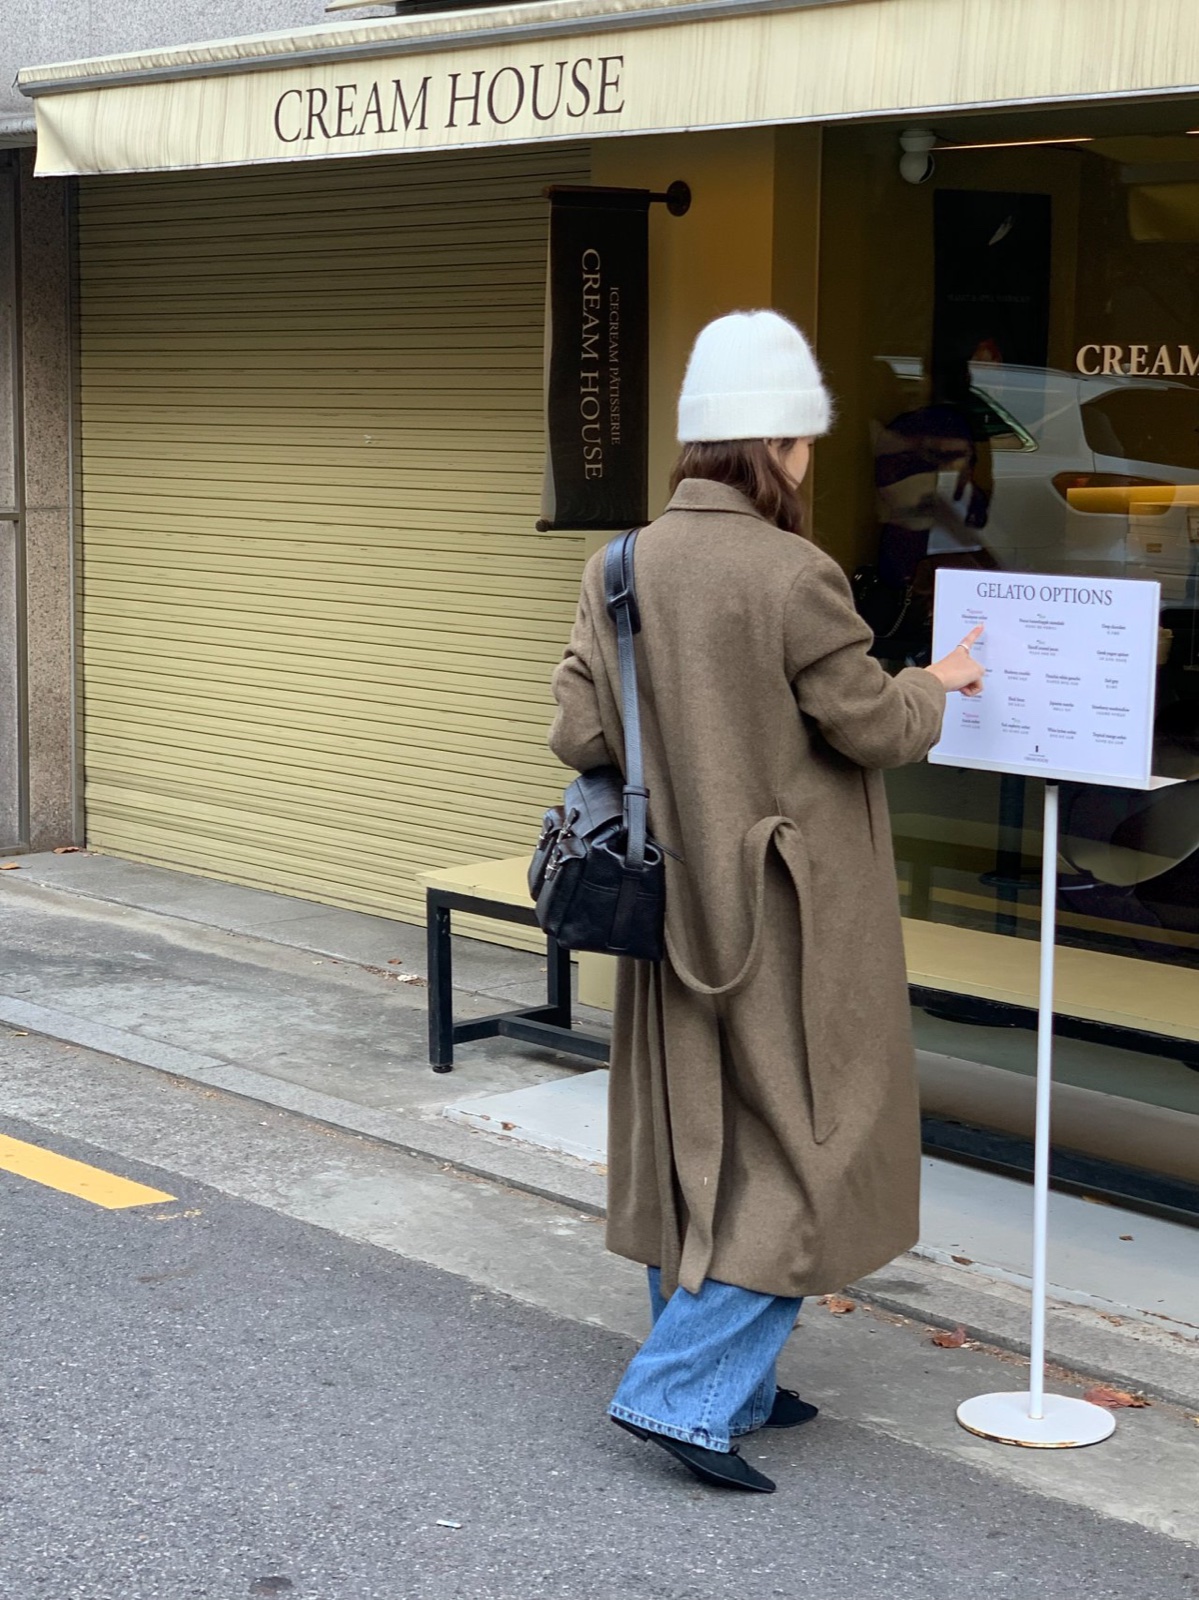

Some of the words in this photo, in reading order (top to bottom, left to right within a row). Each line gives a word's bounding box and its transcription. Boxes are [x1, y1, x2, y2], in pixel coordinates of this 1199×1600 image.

[274, 77, 432, 143] CREAM
[445, 55, 625, 129] HOUSE
[580, 248, 600, 361] CREAM
[608, 286, 620, 363] ICECREAM
[1075, 344, 1199, 376] CREAM
[580, 369, 603, 480] HOUSE
[976, 582, 1036, 600] GELATO
[1039, 586, 1113, 606] OPTIONS
